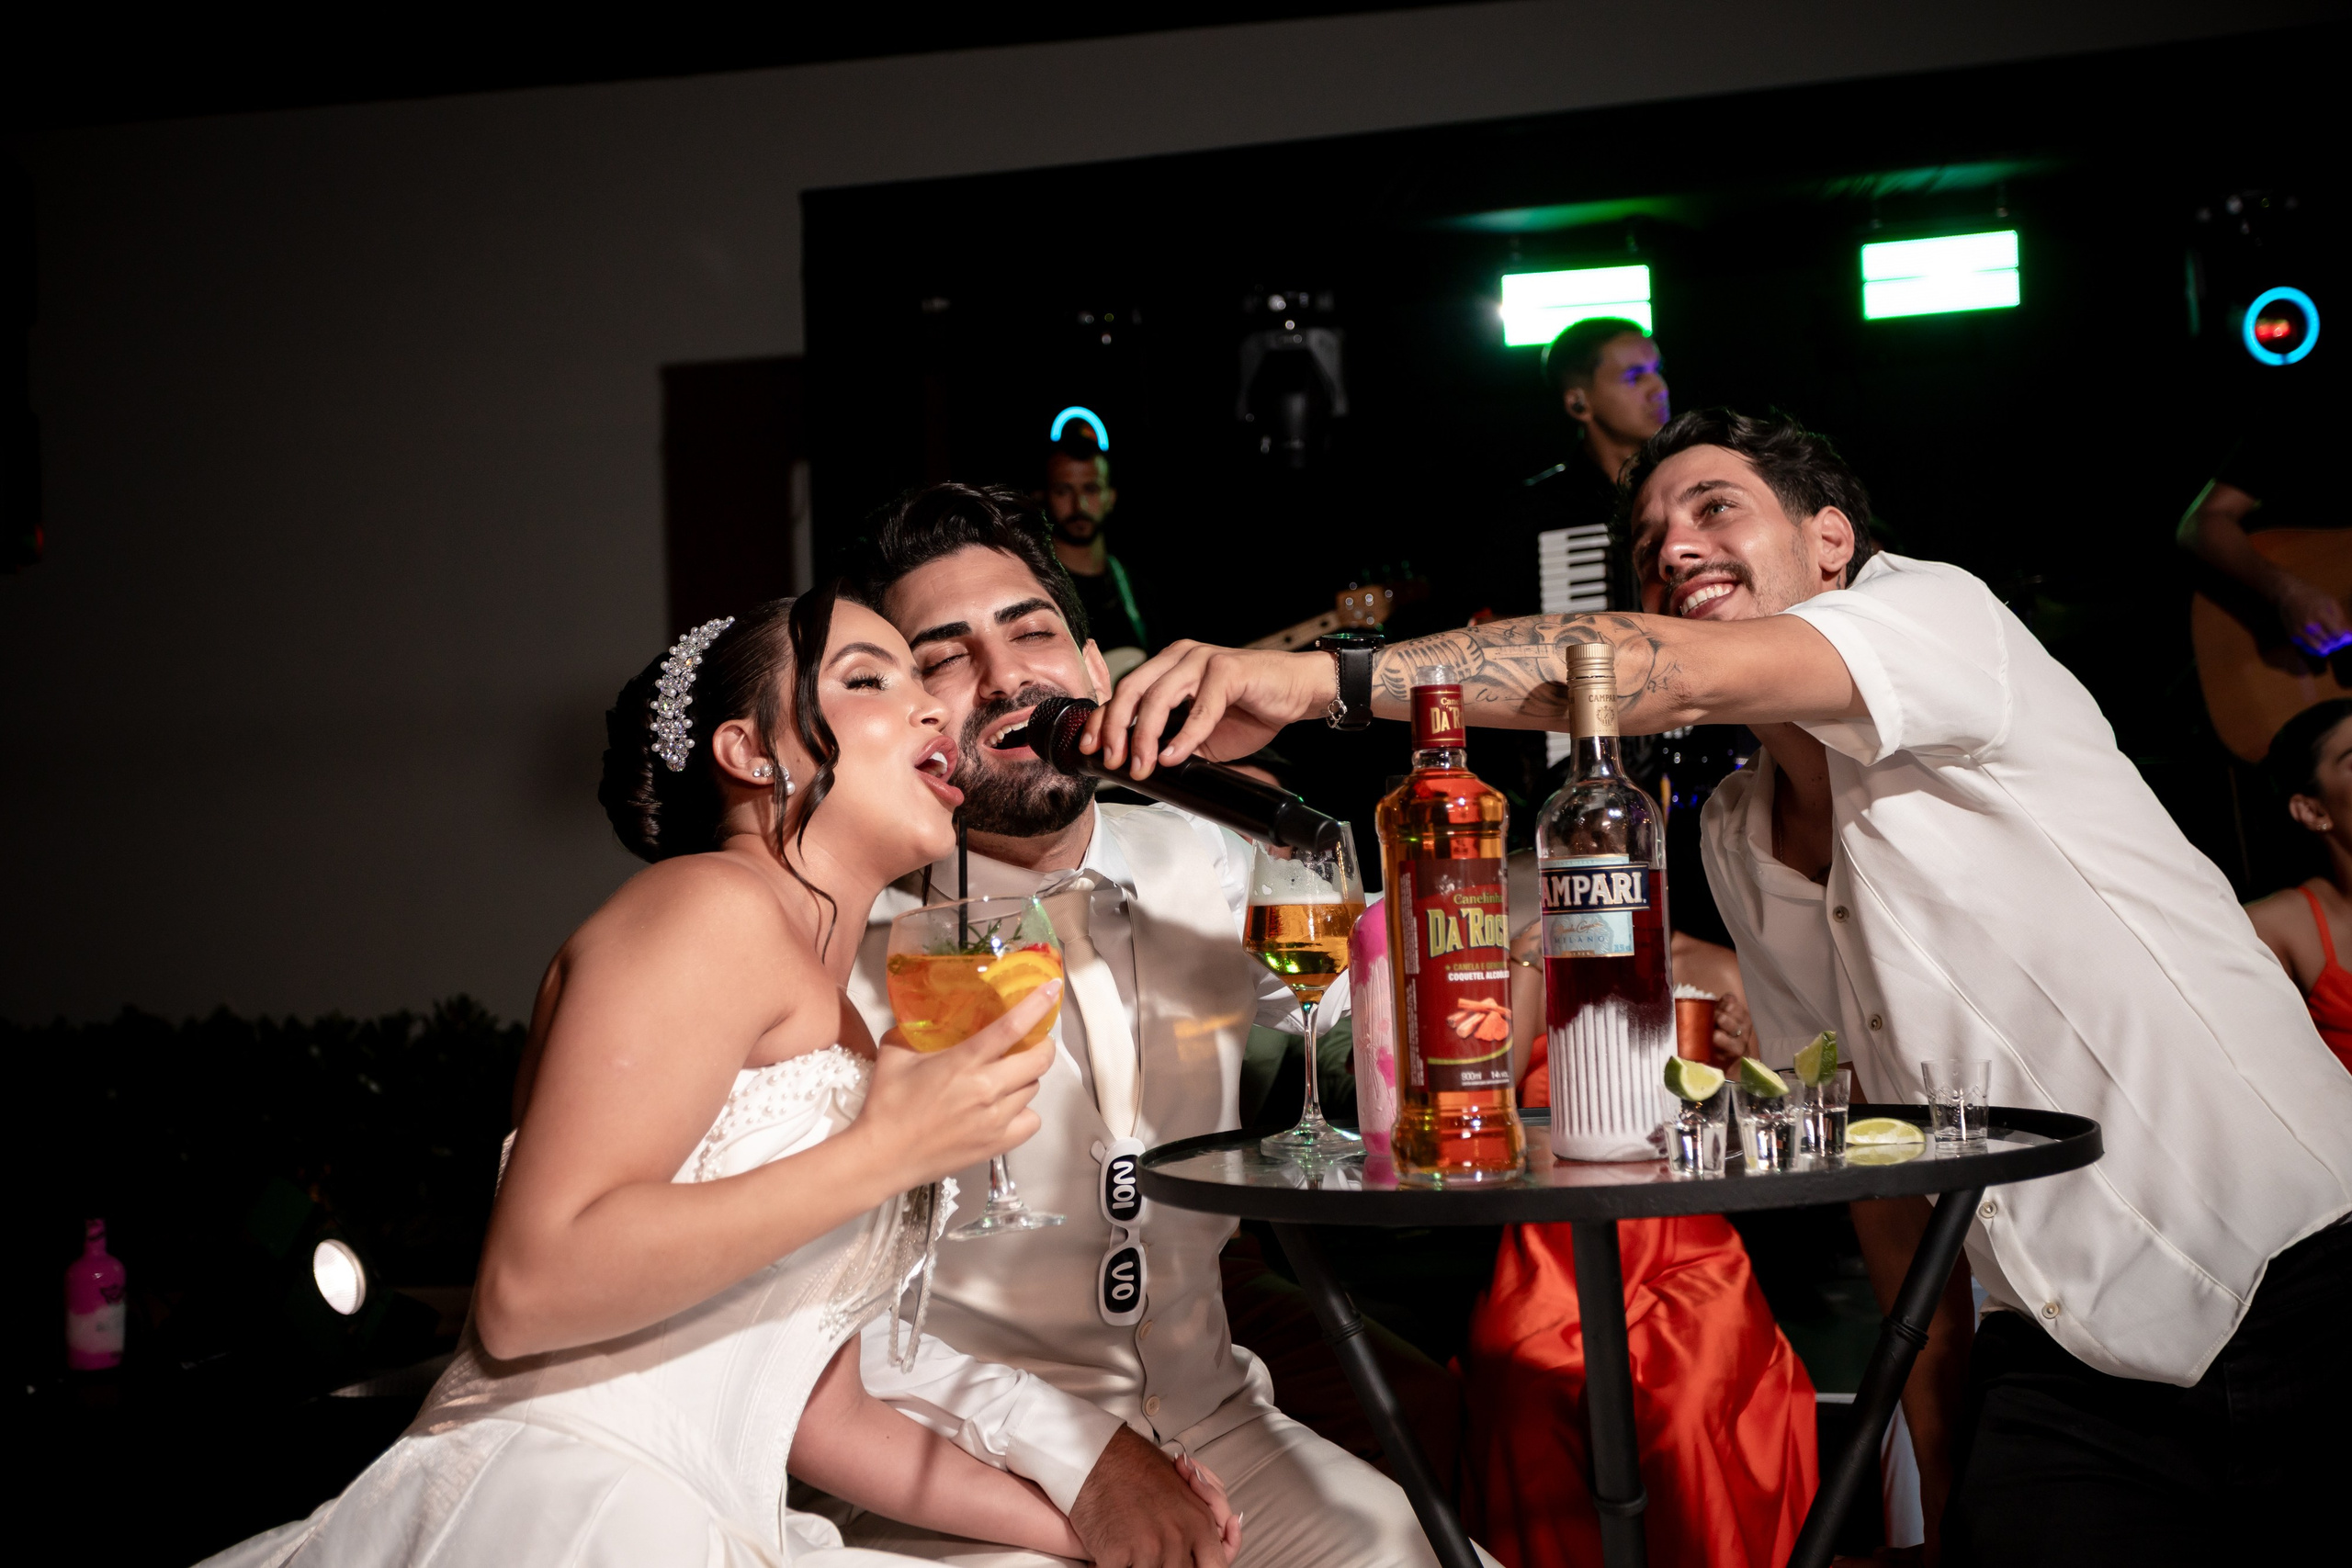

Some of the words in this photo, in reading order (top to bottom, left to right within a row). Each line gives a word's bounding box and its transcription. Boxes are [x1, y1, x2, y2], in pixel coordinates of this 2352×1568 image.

[1440, 696, 1462, 705] Cane
[1589, 694, 1617, 703] CAMPAR
[1430, 705, 1463, 735] DA'R
[1540, 871, 1643, 908] AMPARI
[1555, 935, 1605, 944] MILANO
[1448, 971, 1485, 982] COQUETEL
[1461, 1071, 1482, 1081] 900ml
[1112, 1160, 1136, 1210] NOI
[1111, 1260, 1135, 1301] VO
